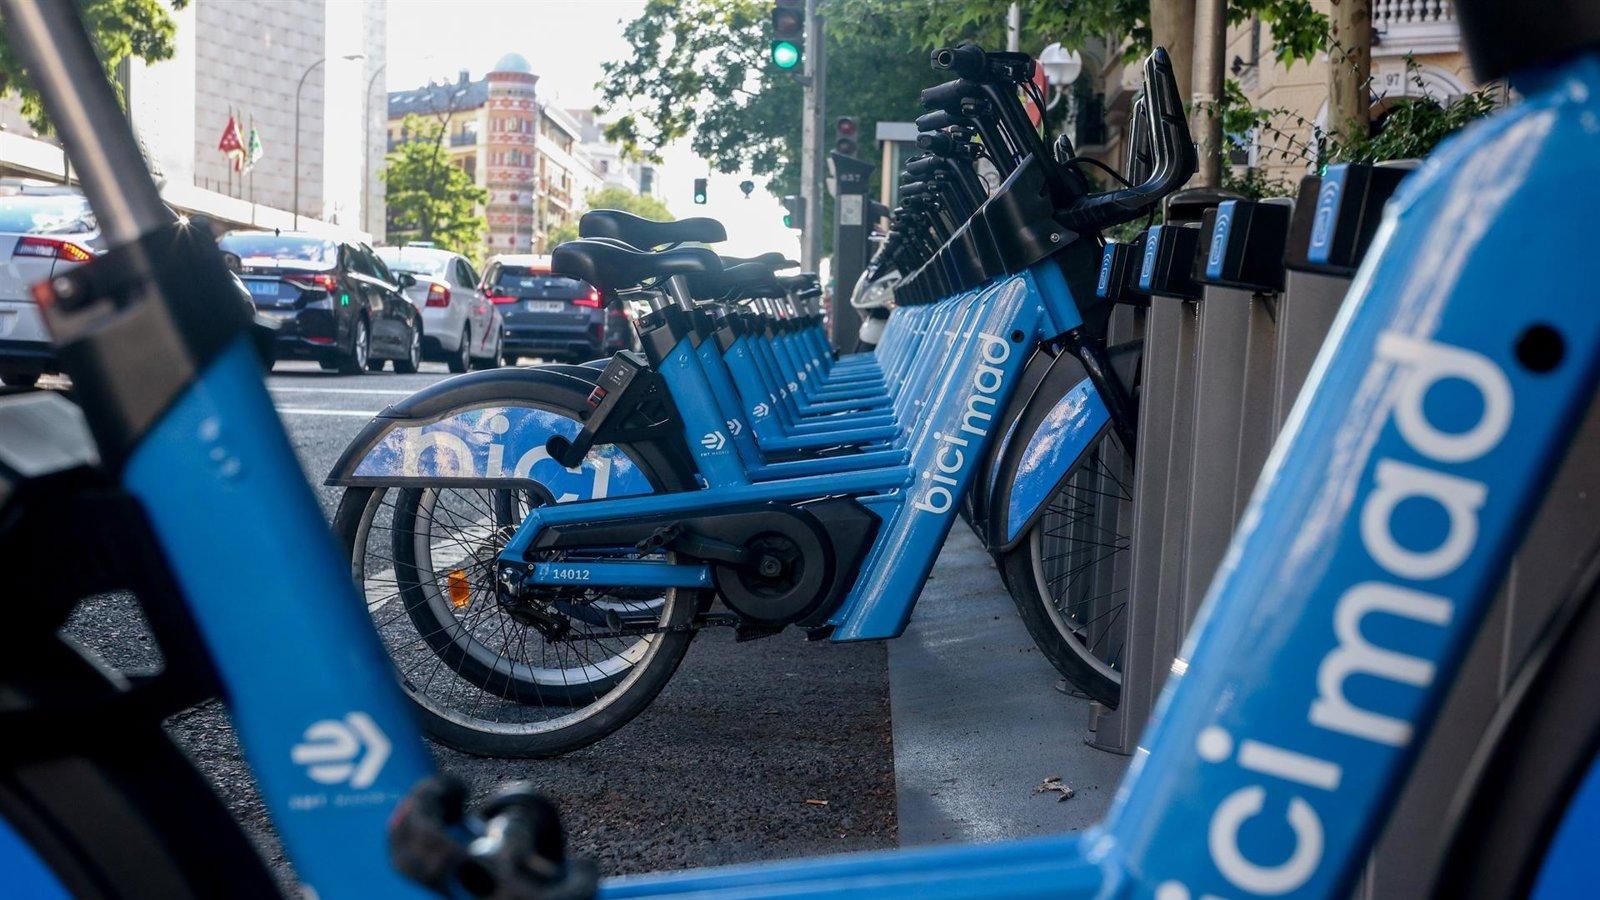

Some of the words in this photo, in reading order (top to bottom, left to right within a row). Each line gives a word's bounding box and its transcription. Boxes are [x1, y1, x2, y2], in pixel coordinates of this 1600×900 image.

[1386, 73, 1400, 86] 97
[915, 431, 969, 514] bici
[961, 331, 1011, 437] mad
[553, 569, 590, 580] 14012
[1308, 330, 1515, 748] mad
